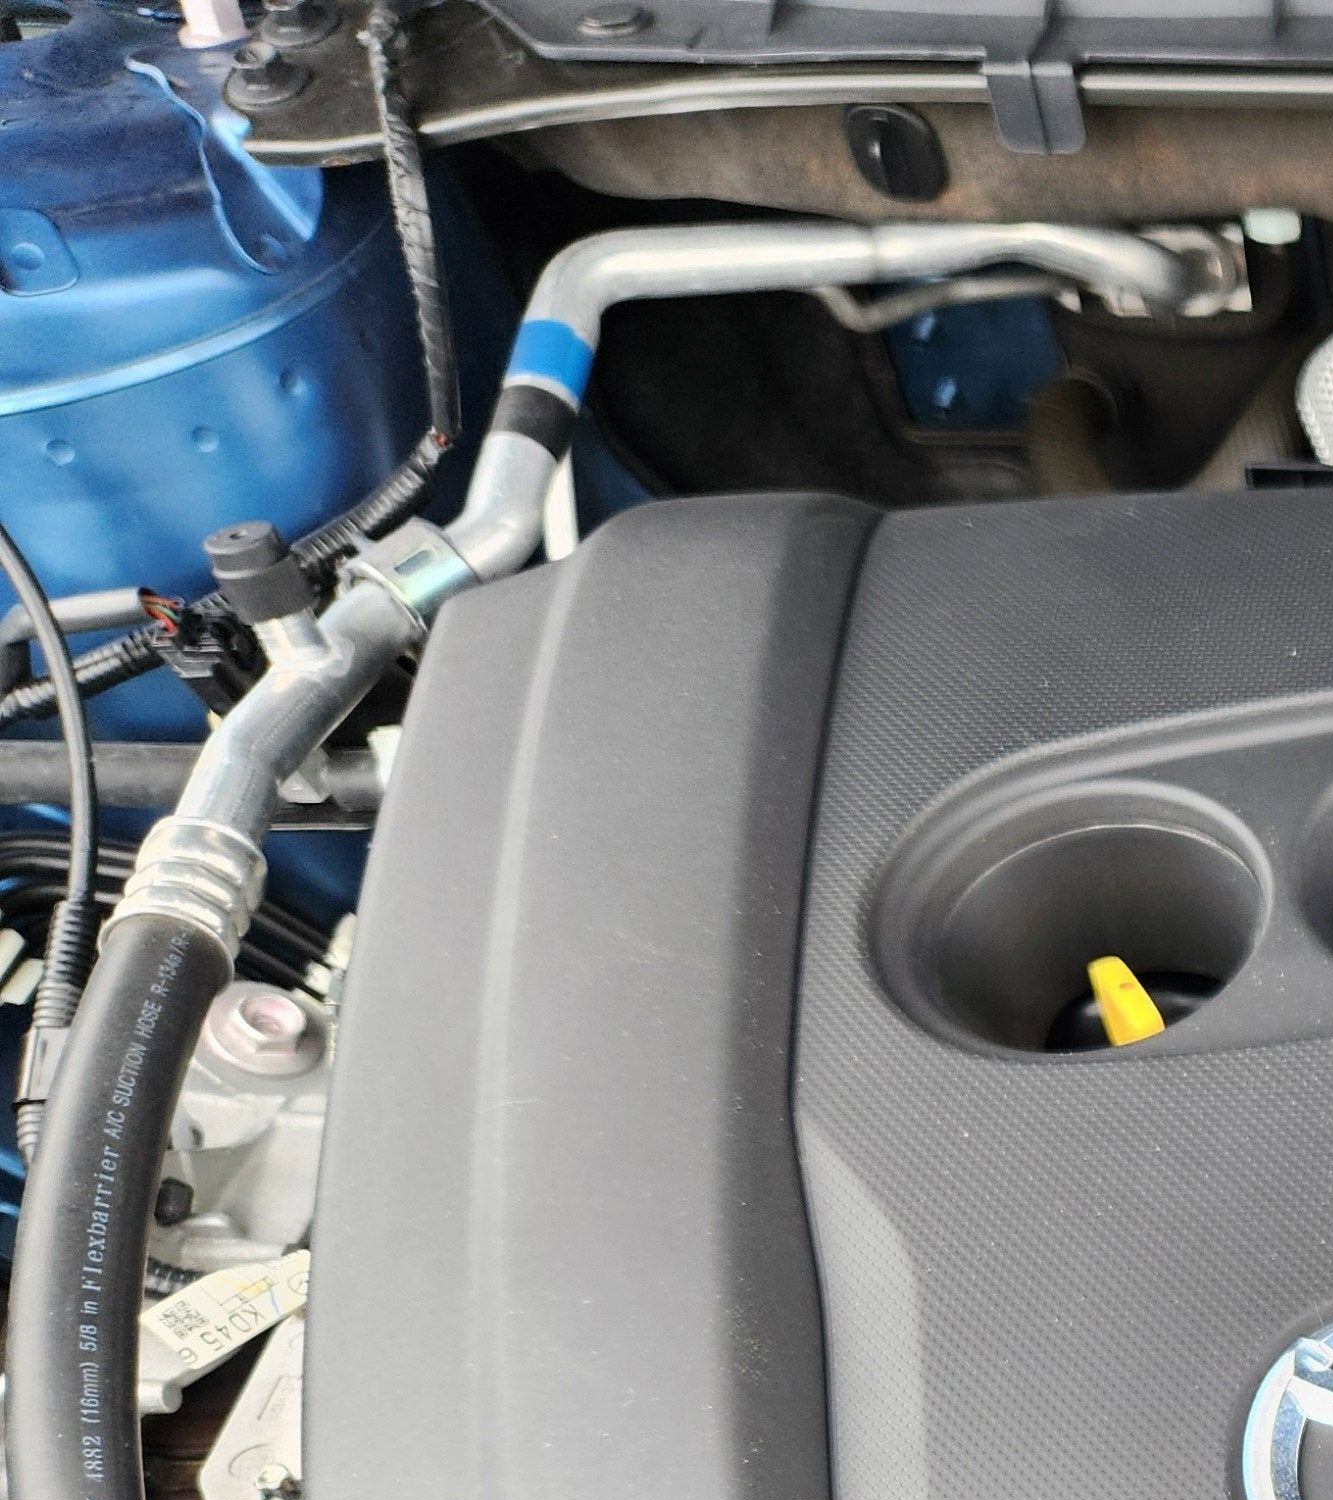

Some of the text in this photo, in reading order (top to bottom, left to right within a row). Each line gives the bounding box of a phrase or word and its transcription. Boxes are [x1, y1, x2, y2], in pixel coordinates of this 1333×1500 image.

[134, 998, 162, 1039] HOSE
[112, 1042, 146, 1107] SUCTION
[104, 1110, 125, 1139] A/C
[82, 1146, 119, 1291] Flexbarrier
[80, 1300, 98, 1315] in
[79, 1324, 98, 1351] 5/8
[79, 1361, 101, 1424] (16mm)
[82, 1435, 104, 1483] 4882
